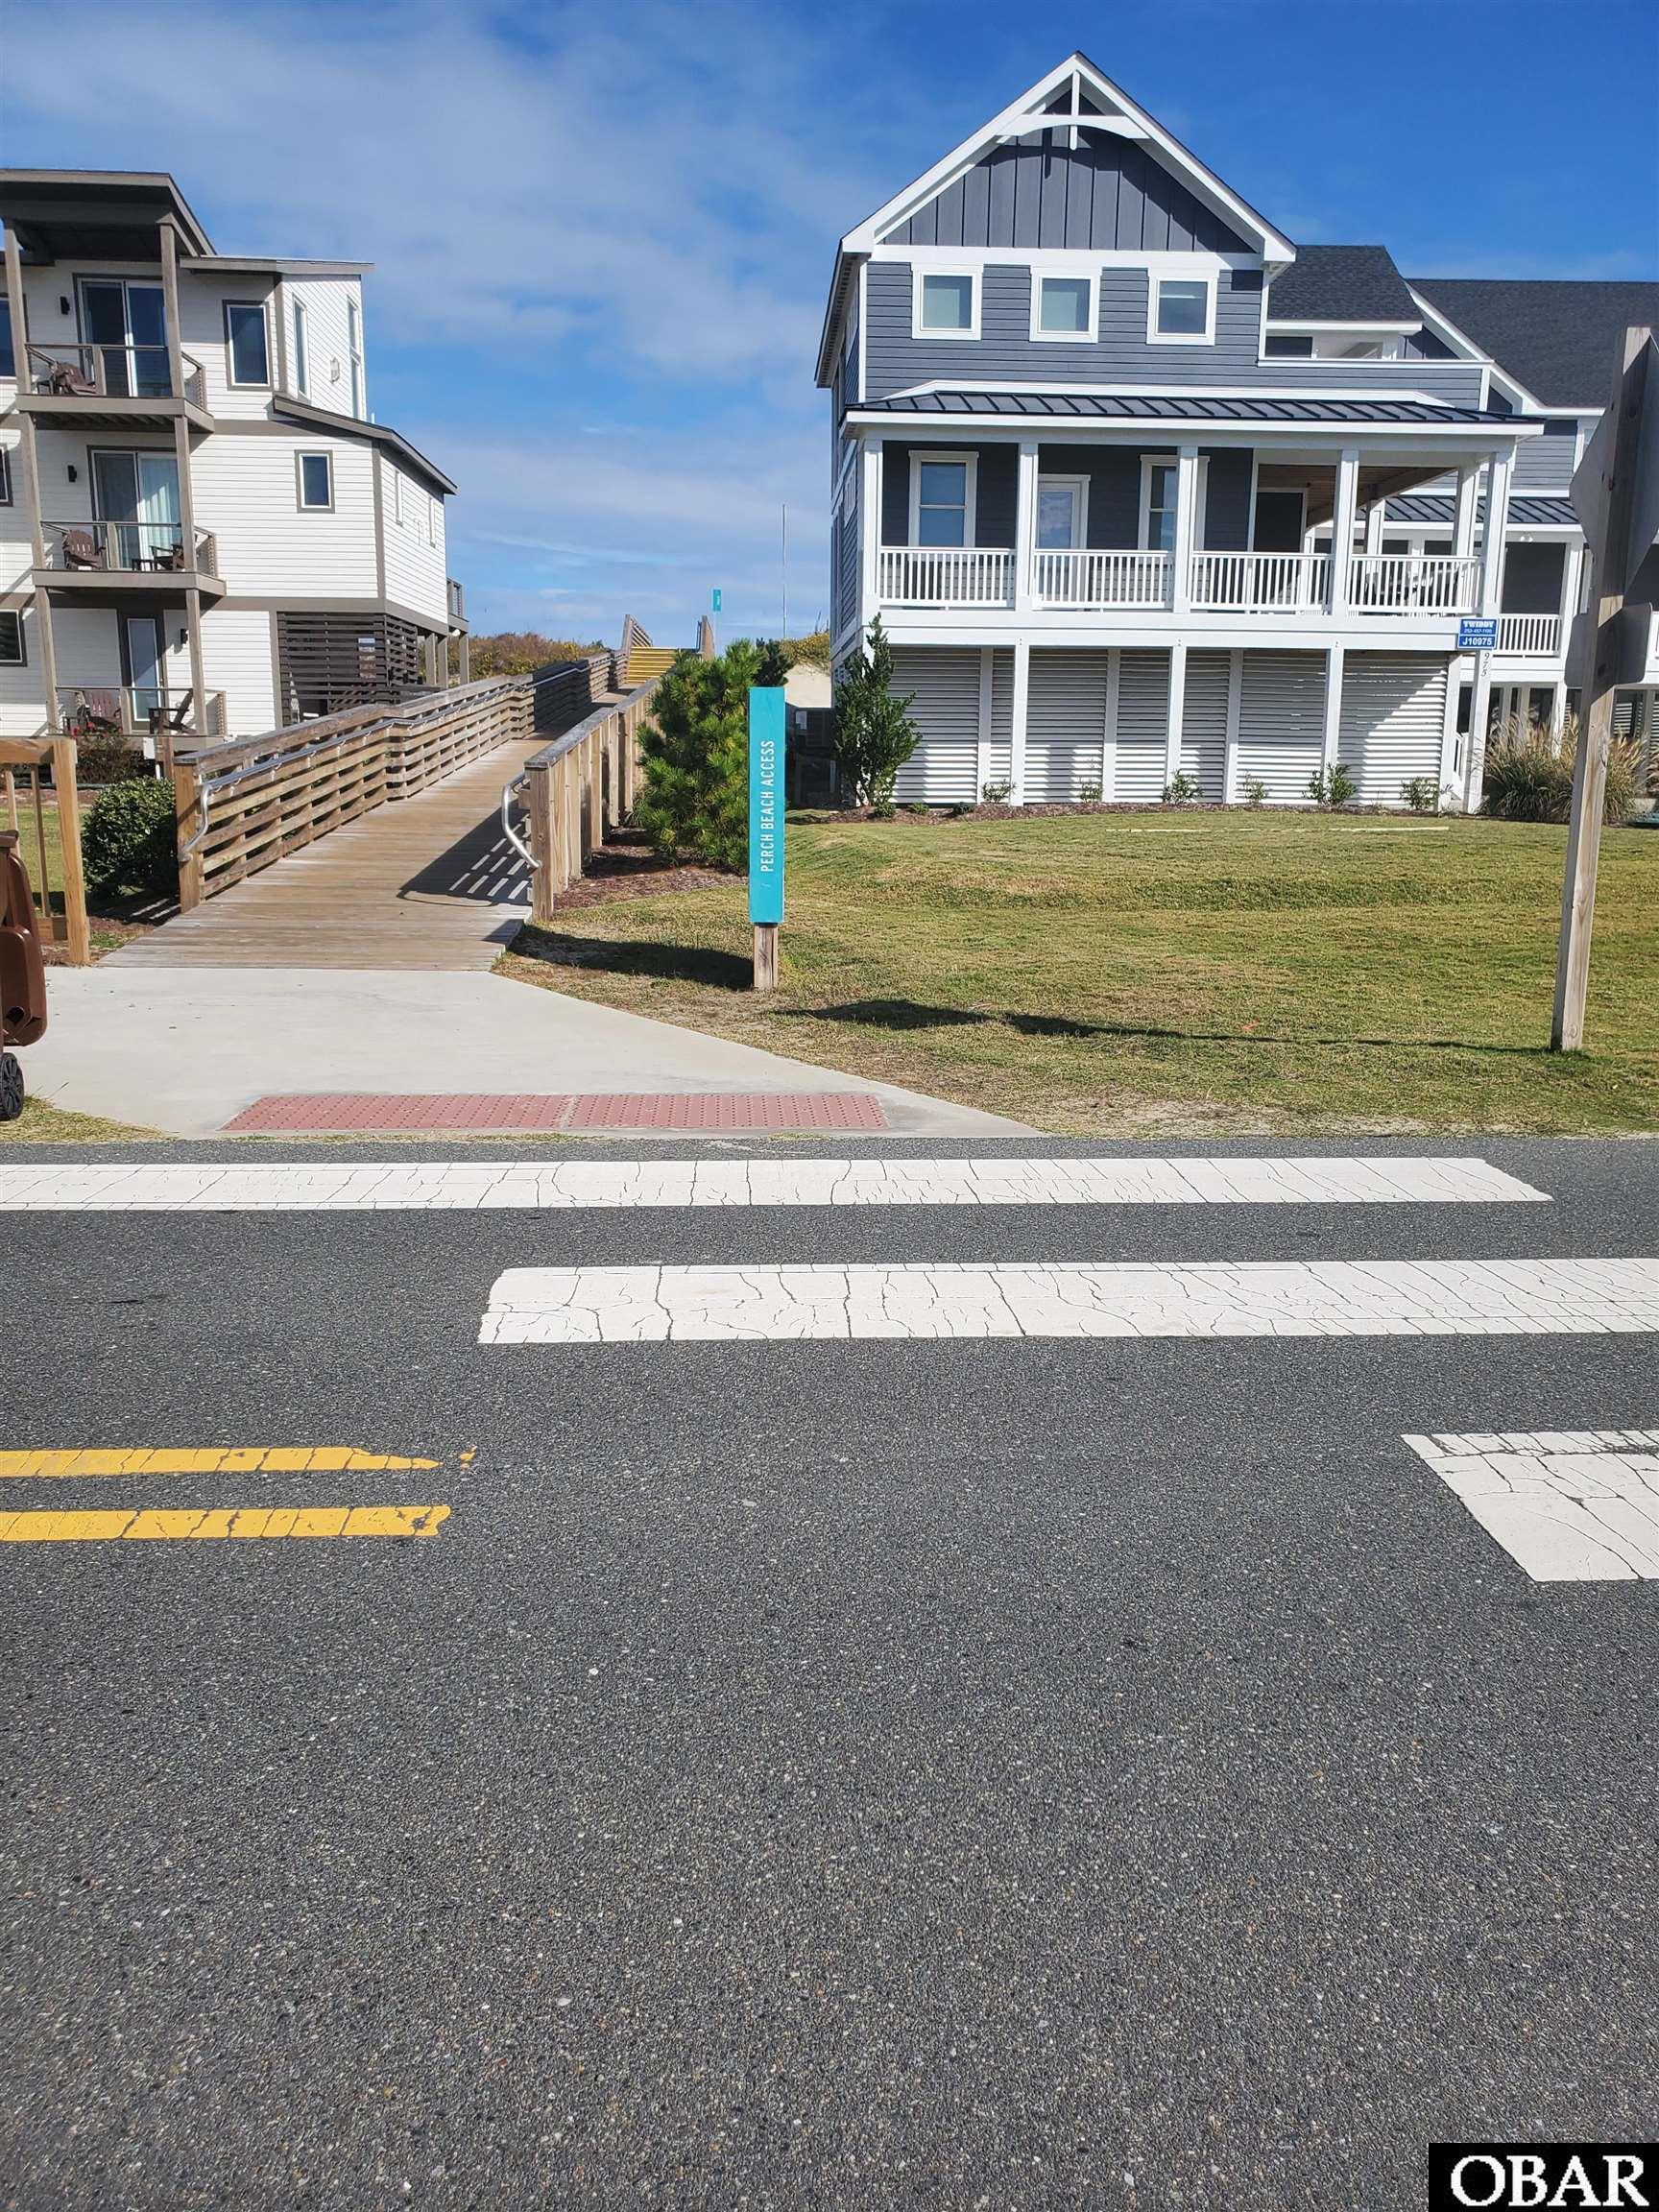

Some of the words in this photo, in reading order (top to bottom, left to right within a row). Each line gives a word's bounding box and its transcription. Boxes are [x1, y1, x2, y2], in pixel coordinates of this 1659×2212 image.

[1462, 637, 1493, 646] J10975
[1481, 653, 1490, 677] 975
[760, 739, 775, 787] ACCESS
[760, 791, 775, 831] BEACH
[760, 833, 774, 873] PERCH
